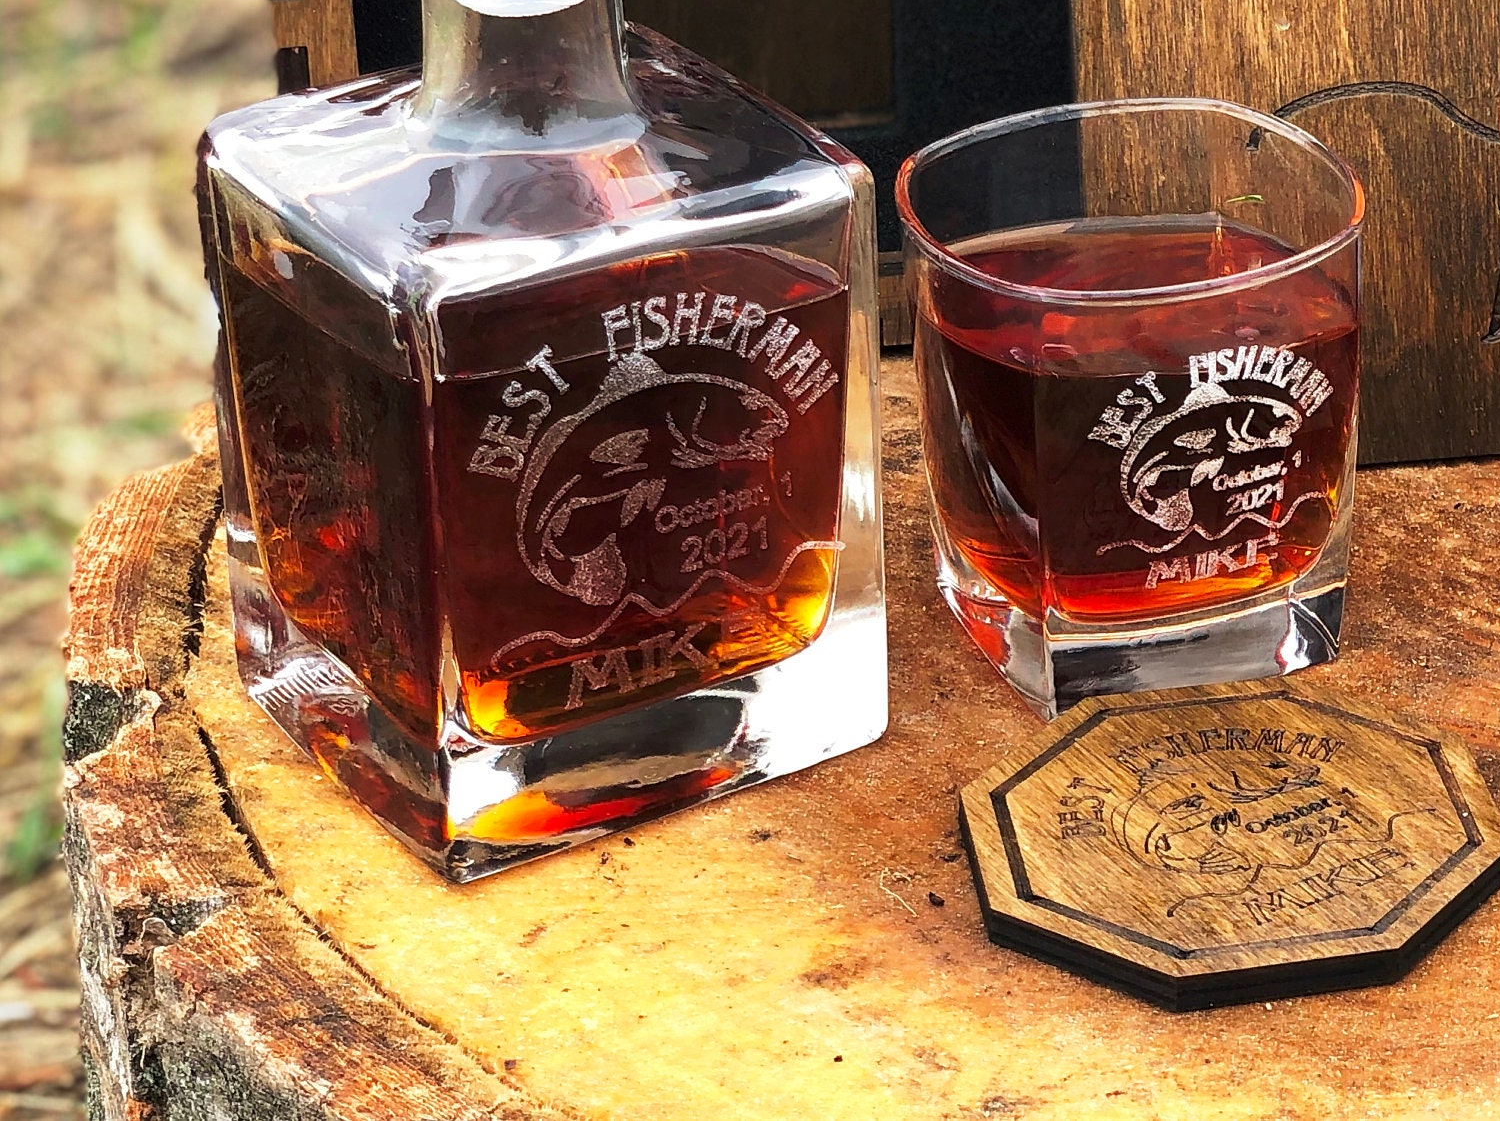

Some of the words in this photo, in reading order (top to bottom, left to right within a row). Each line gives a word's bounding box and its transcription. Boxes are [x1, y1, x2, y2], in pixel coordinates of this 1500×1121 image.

[467, 344, 572, 482] BEST
[601, 291, 840, 415] FISHERMAN
[1087, 371, 1168, 450] BEST
[1188, 344, 1334, 418] FISHERMAN
[1225, 480, 1286, 517] 2021
[679, 514, 769, 573] 2021
[1144, 532, 1280, 590] MIKE
[1282, 808, 1363, 847] 2021
